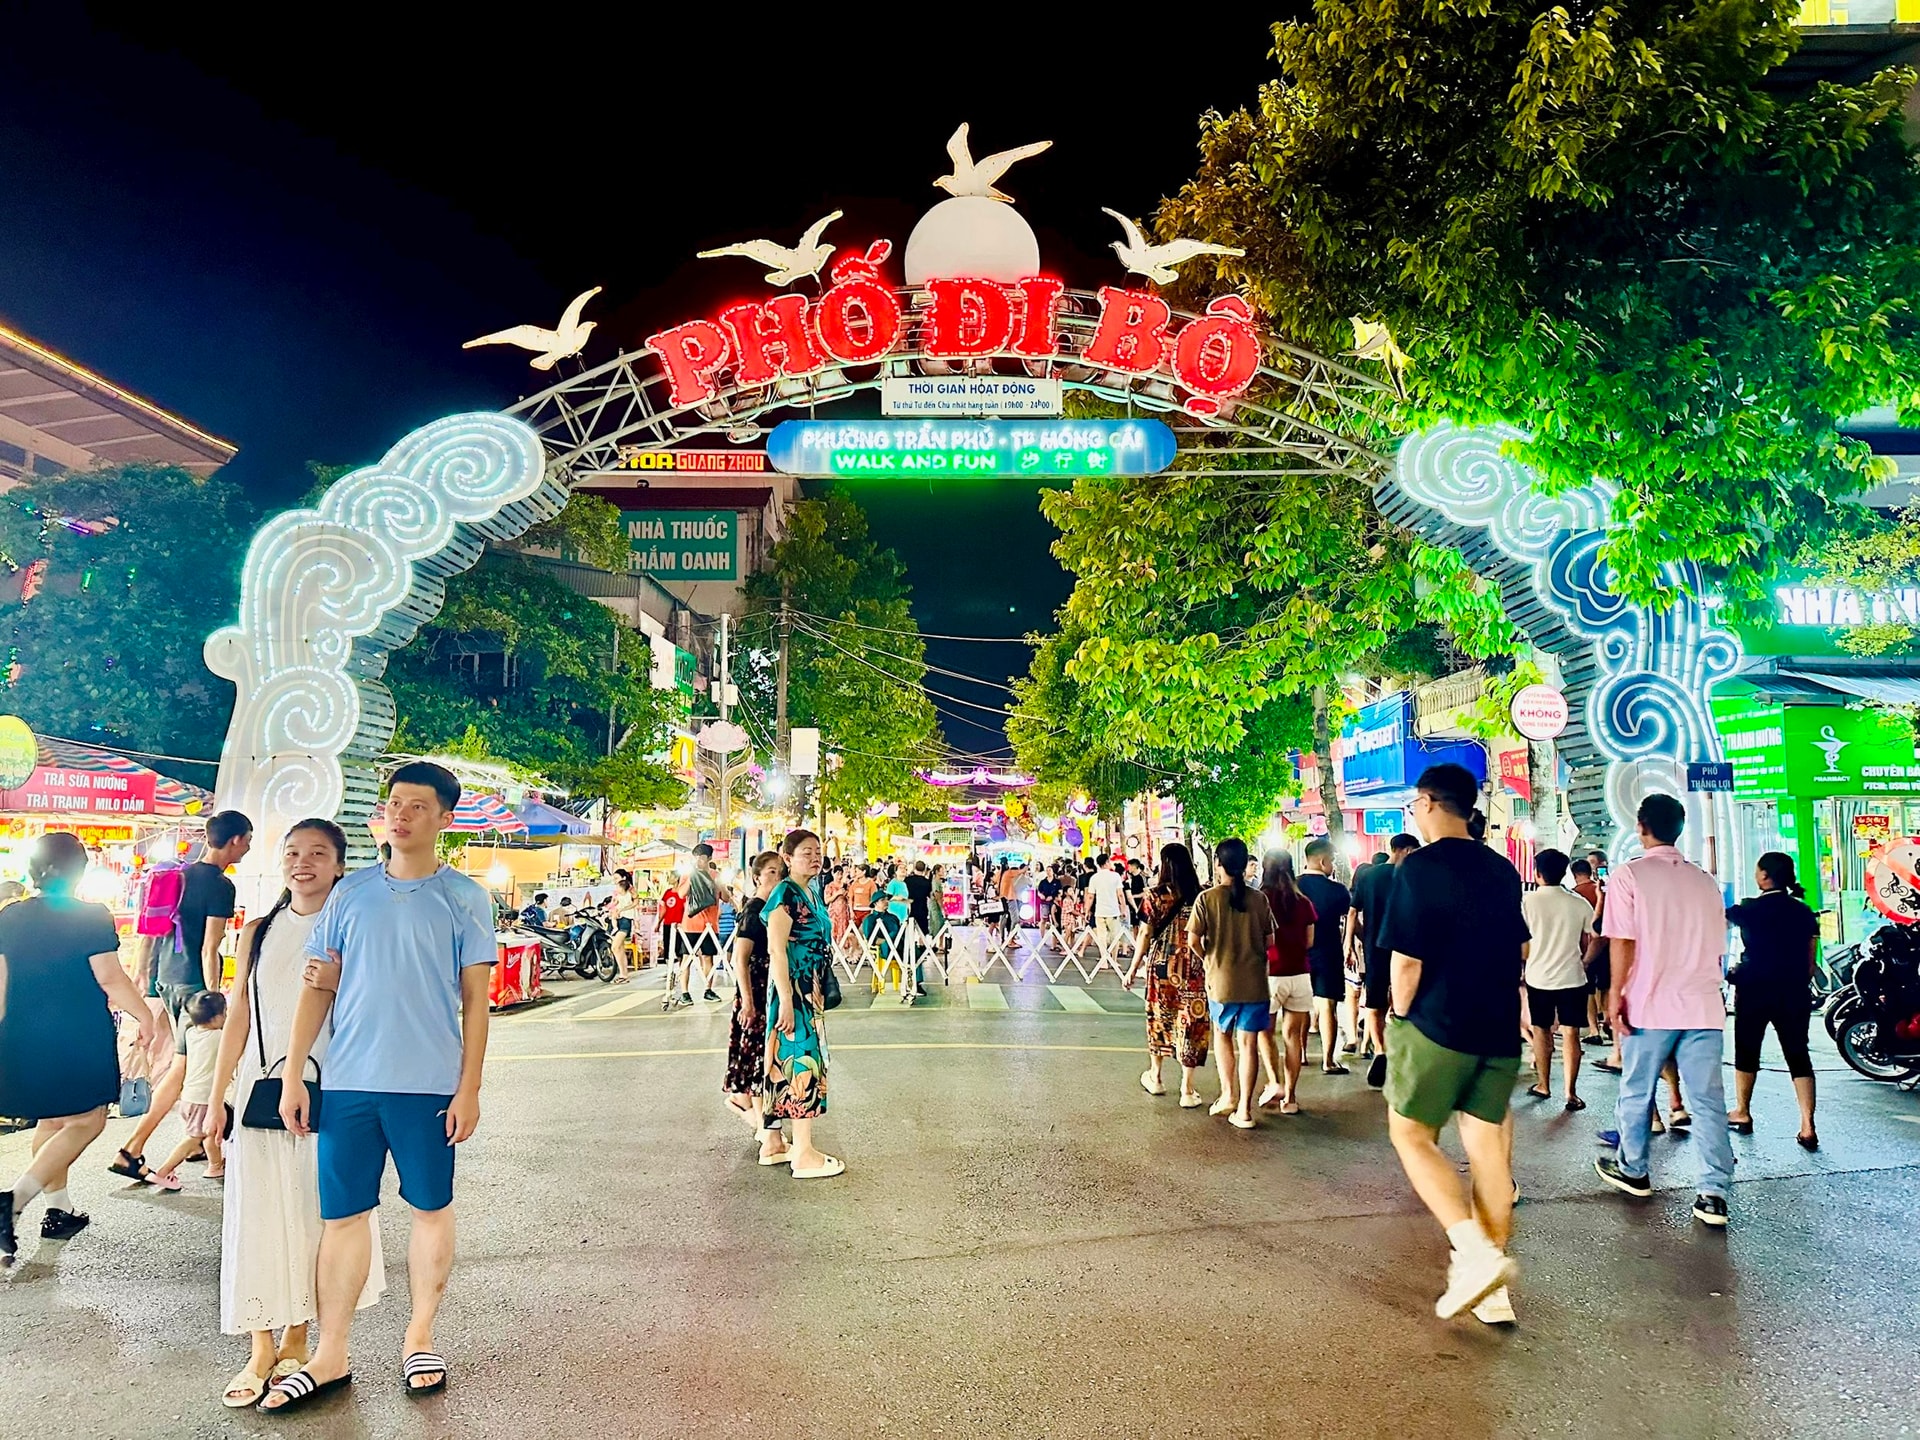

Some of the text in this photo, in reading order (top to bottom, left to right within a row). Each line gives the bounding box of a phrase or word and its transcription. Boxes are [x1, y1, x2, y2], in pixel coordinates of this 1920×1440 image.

[644, 238, 1262, 419] PHỐ ĐI BỘ
[908, 381, 1036, 398] THỜI GIAN HOẠT ĐỘNG
[836, 454, 996, 469] WALK AND FUN
[628, 514, 728, 539] NHÀ THUỐC
[627, 545, 730, 570] THẮM OANH
[1520, 707, 1562, 719] KHÔNG
[1702, 764, 1718, 775] PHỐ
[1861, 764, 1905, 777] CHUYÊN
[43, 770, 65, 787] TRÀ
[93, 774, 128, 792] NƯỚNG
[1691, 777, 1717, 788] THẮNG
[1719, 779, 1731, 790] LỢI
[26, 791, 49, 808] TRÀ
[95, 797, 120, 812] MILO
